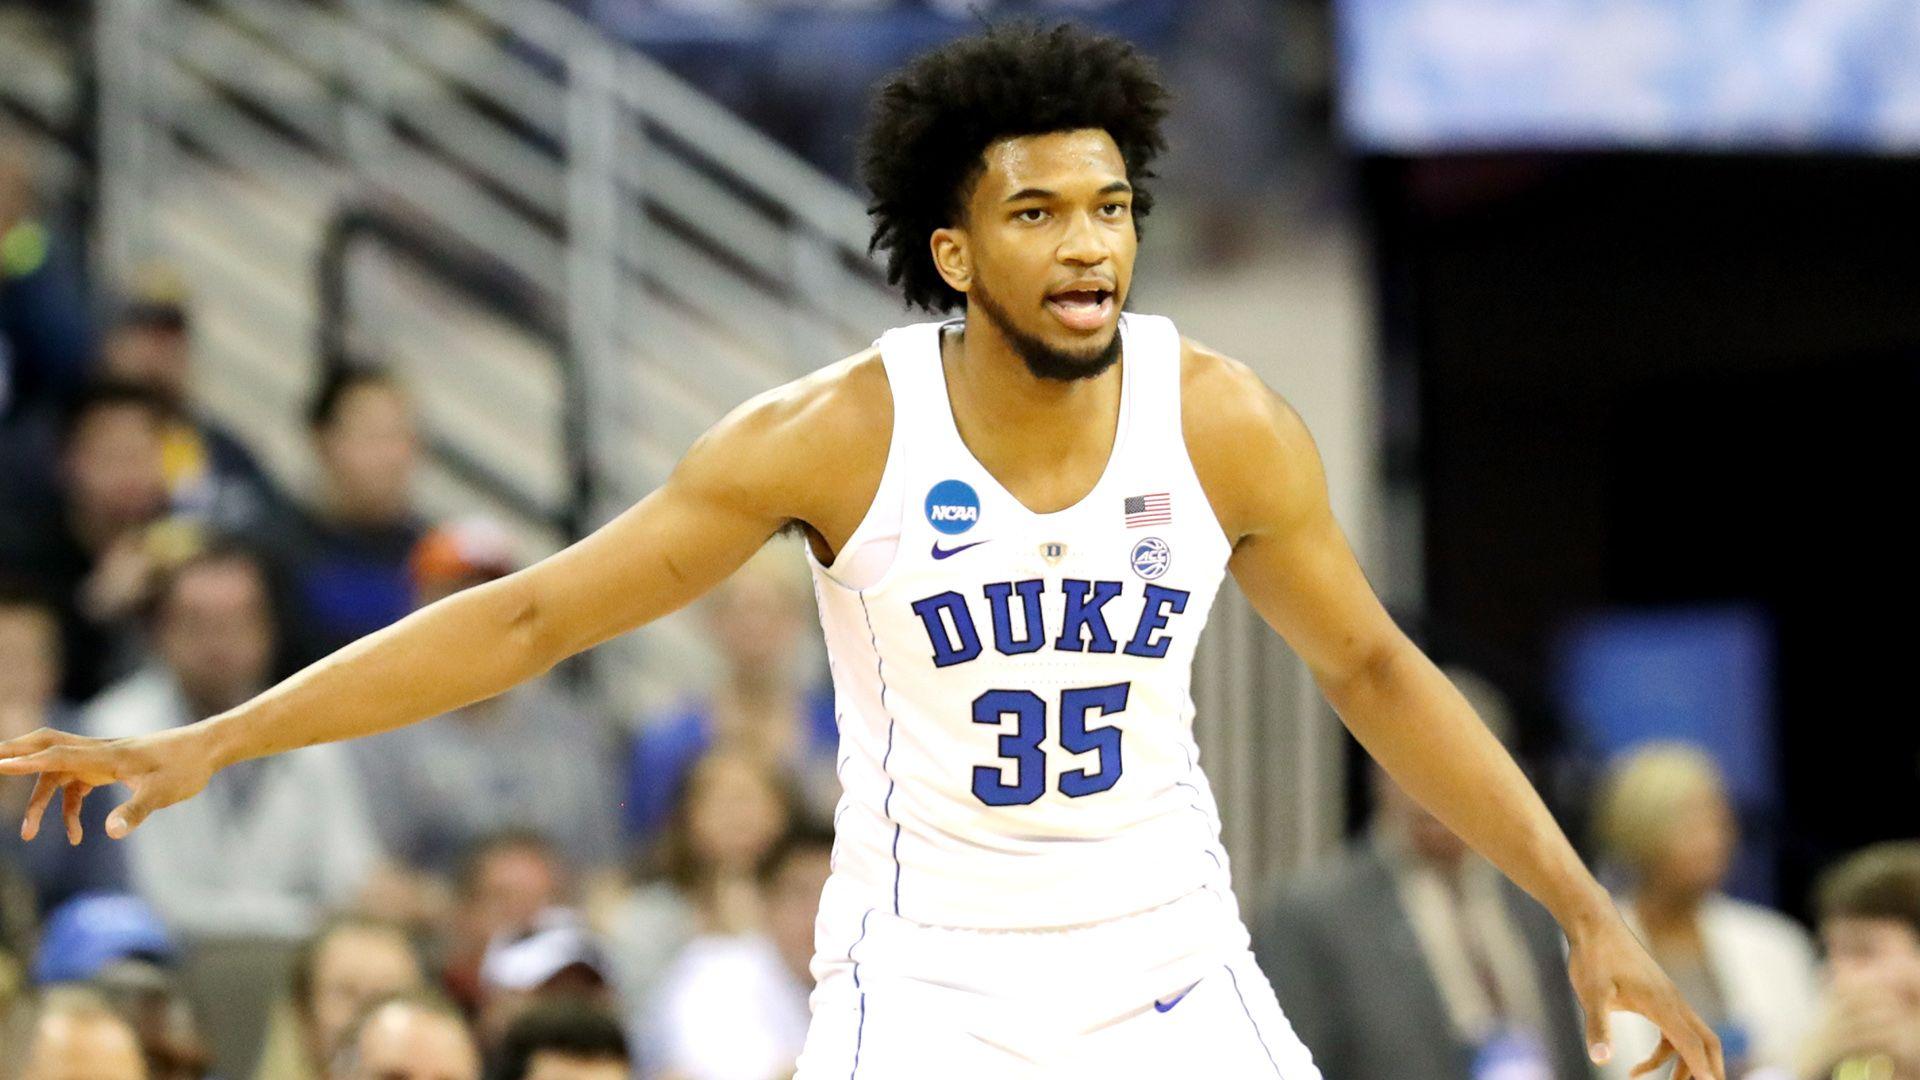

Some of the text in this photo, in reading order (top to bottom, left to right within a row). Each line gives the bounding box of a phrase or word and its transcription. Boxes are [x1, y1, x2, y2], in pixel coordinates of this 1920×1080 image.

[931, 505, 977, 521] NCAA
[1136, 550, 1167, 563] ACC
[911, 578, 1190, 668] DUKE
[972, 681, 1131, 806] 35
